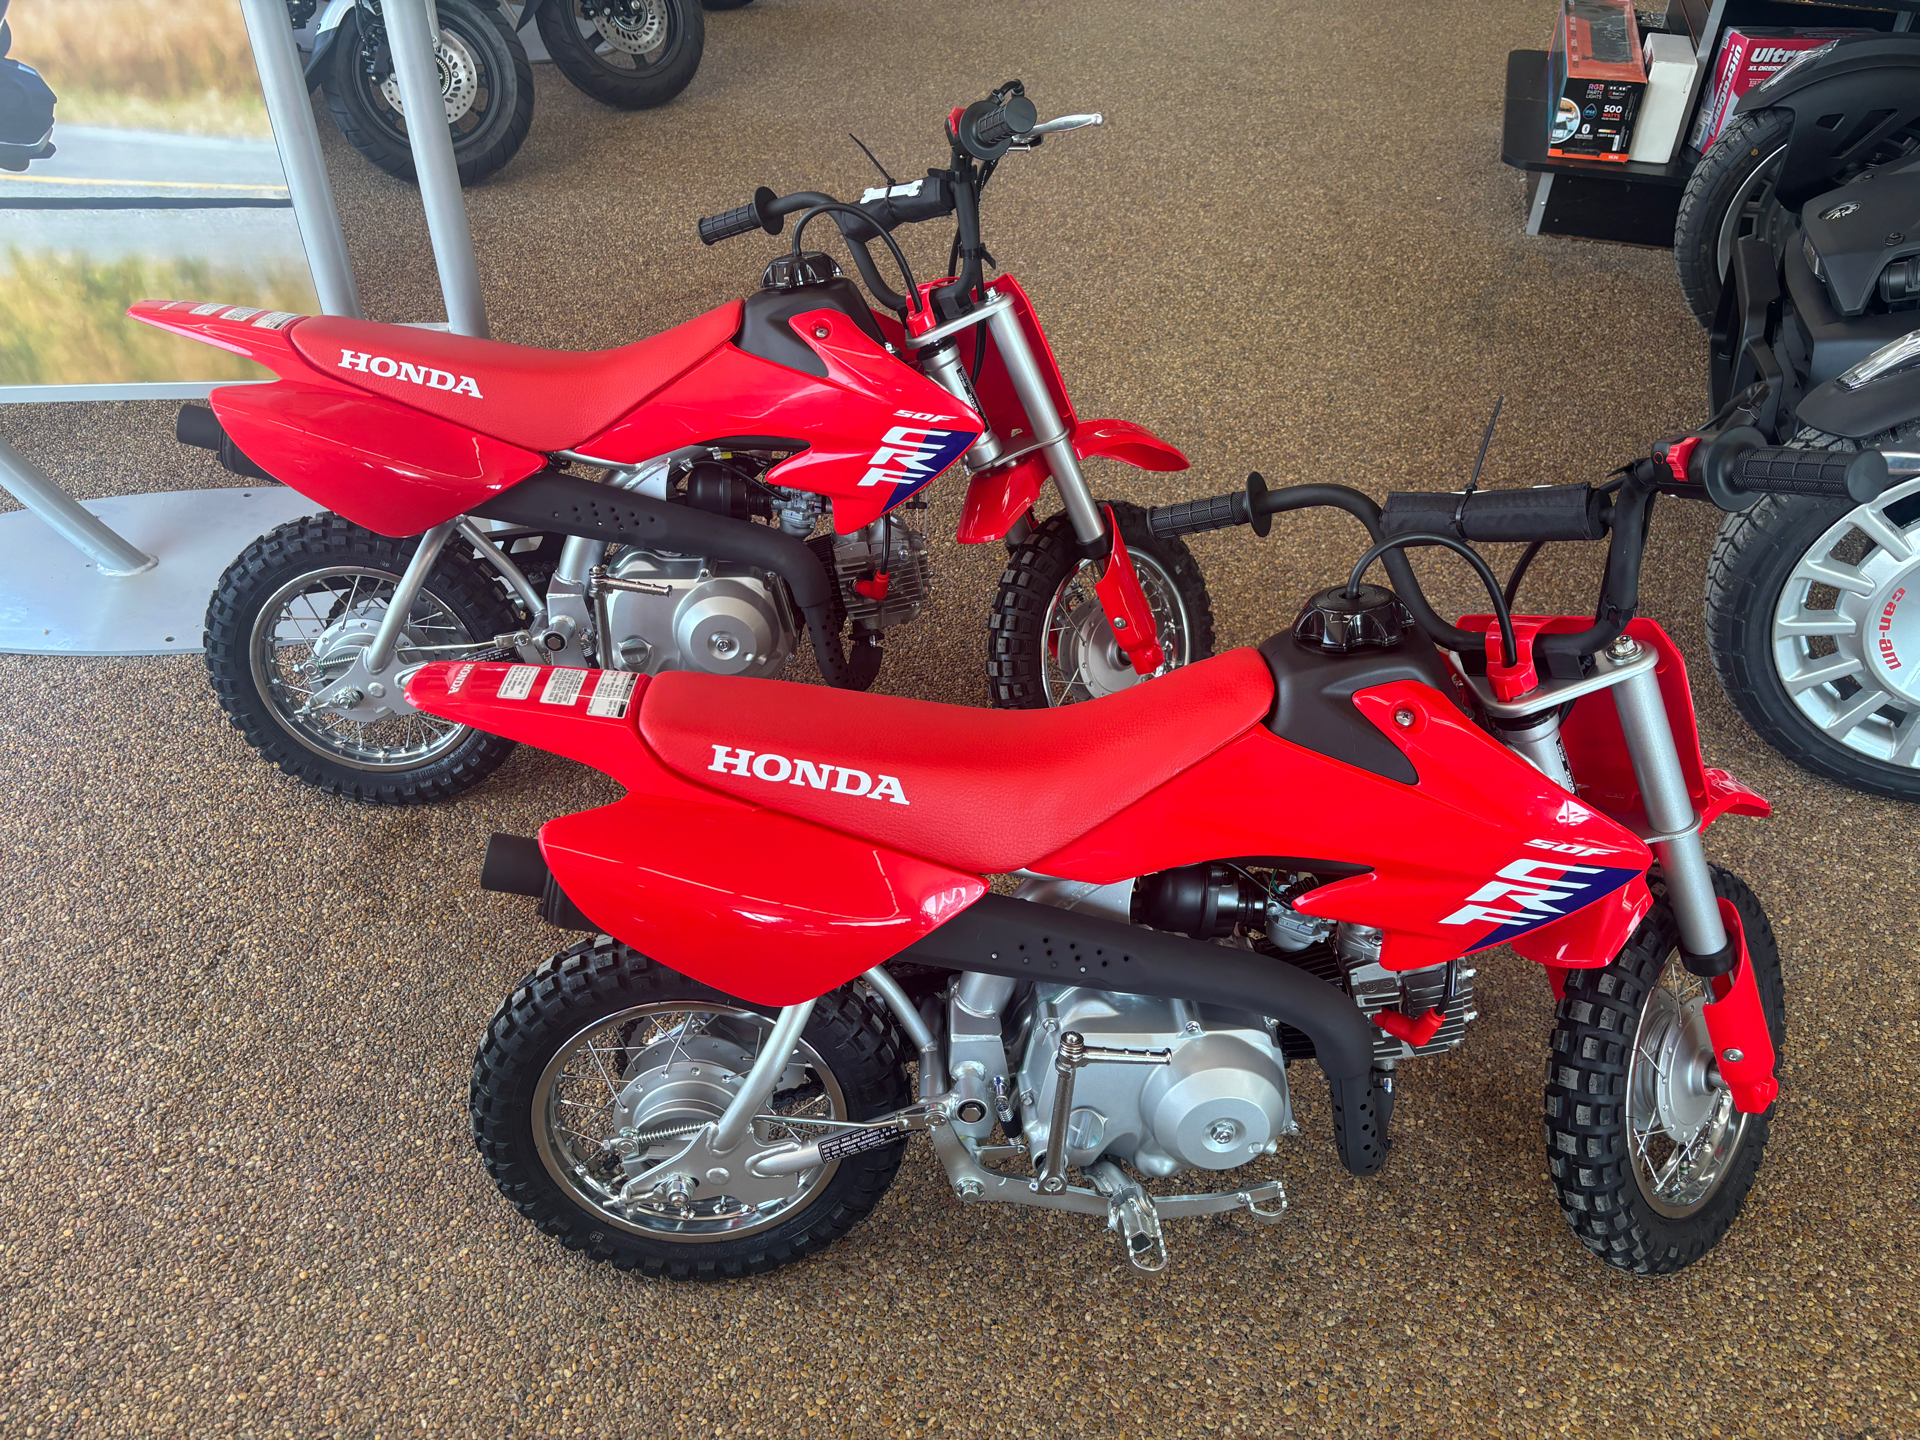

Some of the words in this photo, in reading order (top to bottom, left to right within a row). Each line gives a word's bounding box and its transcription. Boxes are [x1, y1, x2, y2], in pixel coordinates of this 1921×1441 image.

[1603, 105, 1622, 113] 500
[338, 348, 484, 399] HONDA
[892, 409, 958, 422] 50F
[856, 426, 952, 487] CRF
[1879, 587, 1906, 671] can-am
[447, 663, 476, 695] HONDA
[707, 744, 910, 805] HONDA
[1523, 838, 1622, 857] 50F
[1437, 858, 1606, 926] CRF
